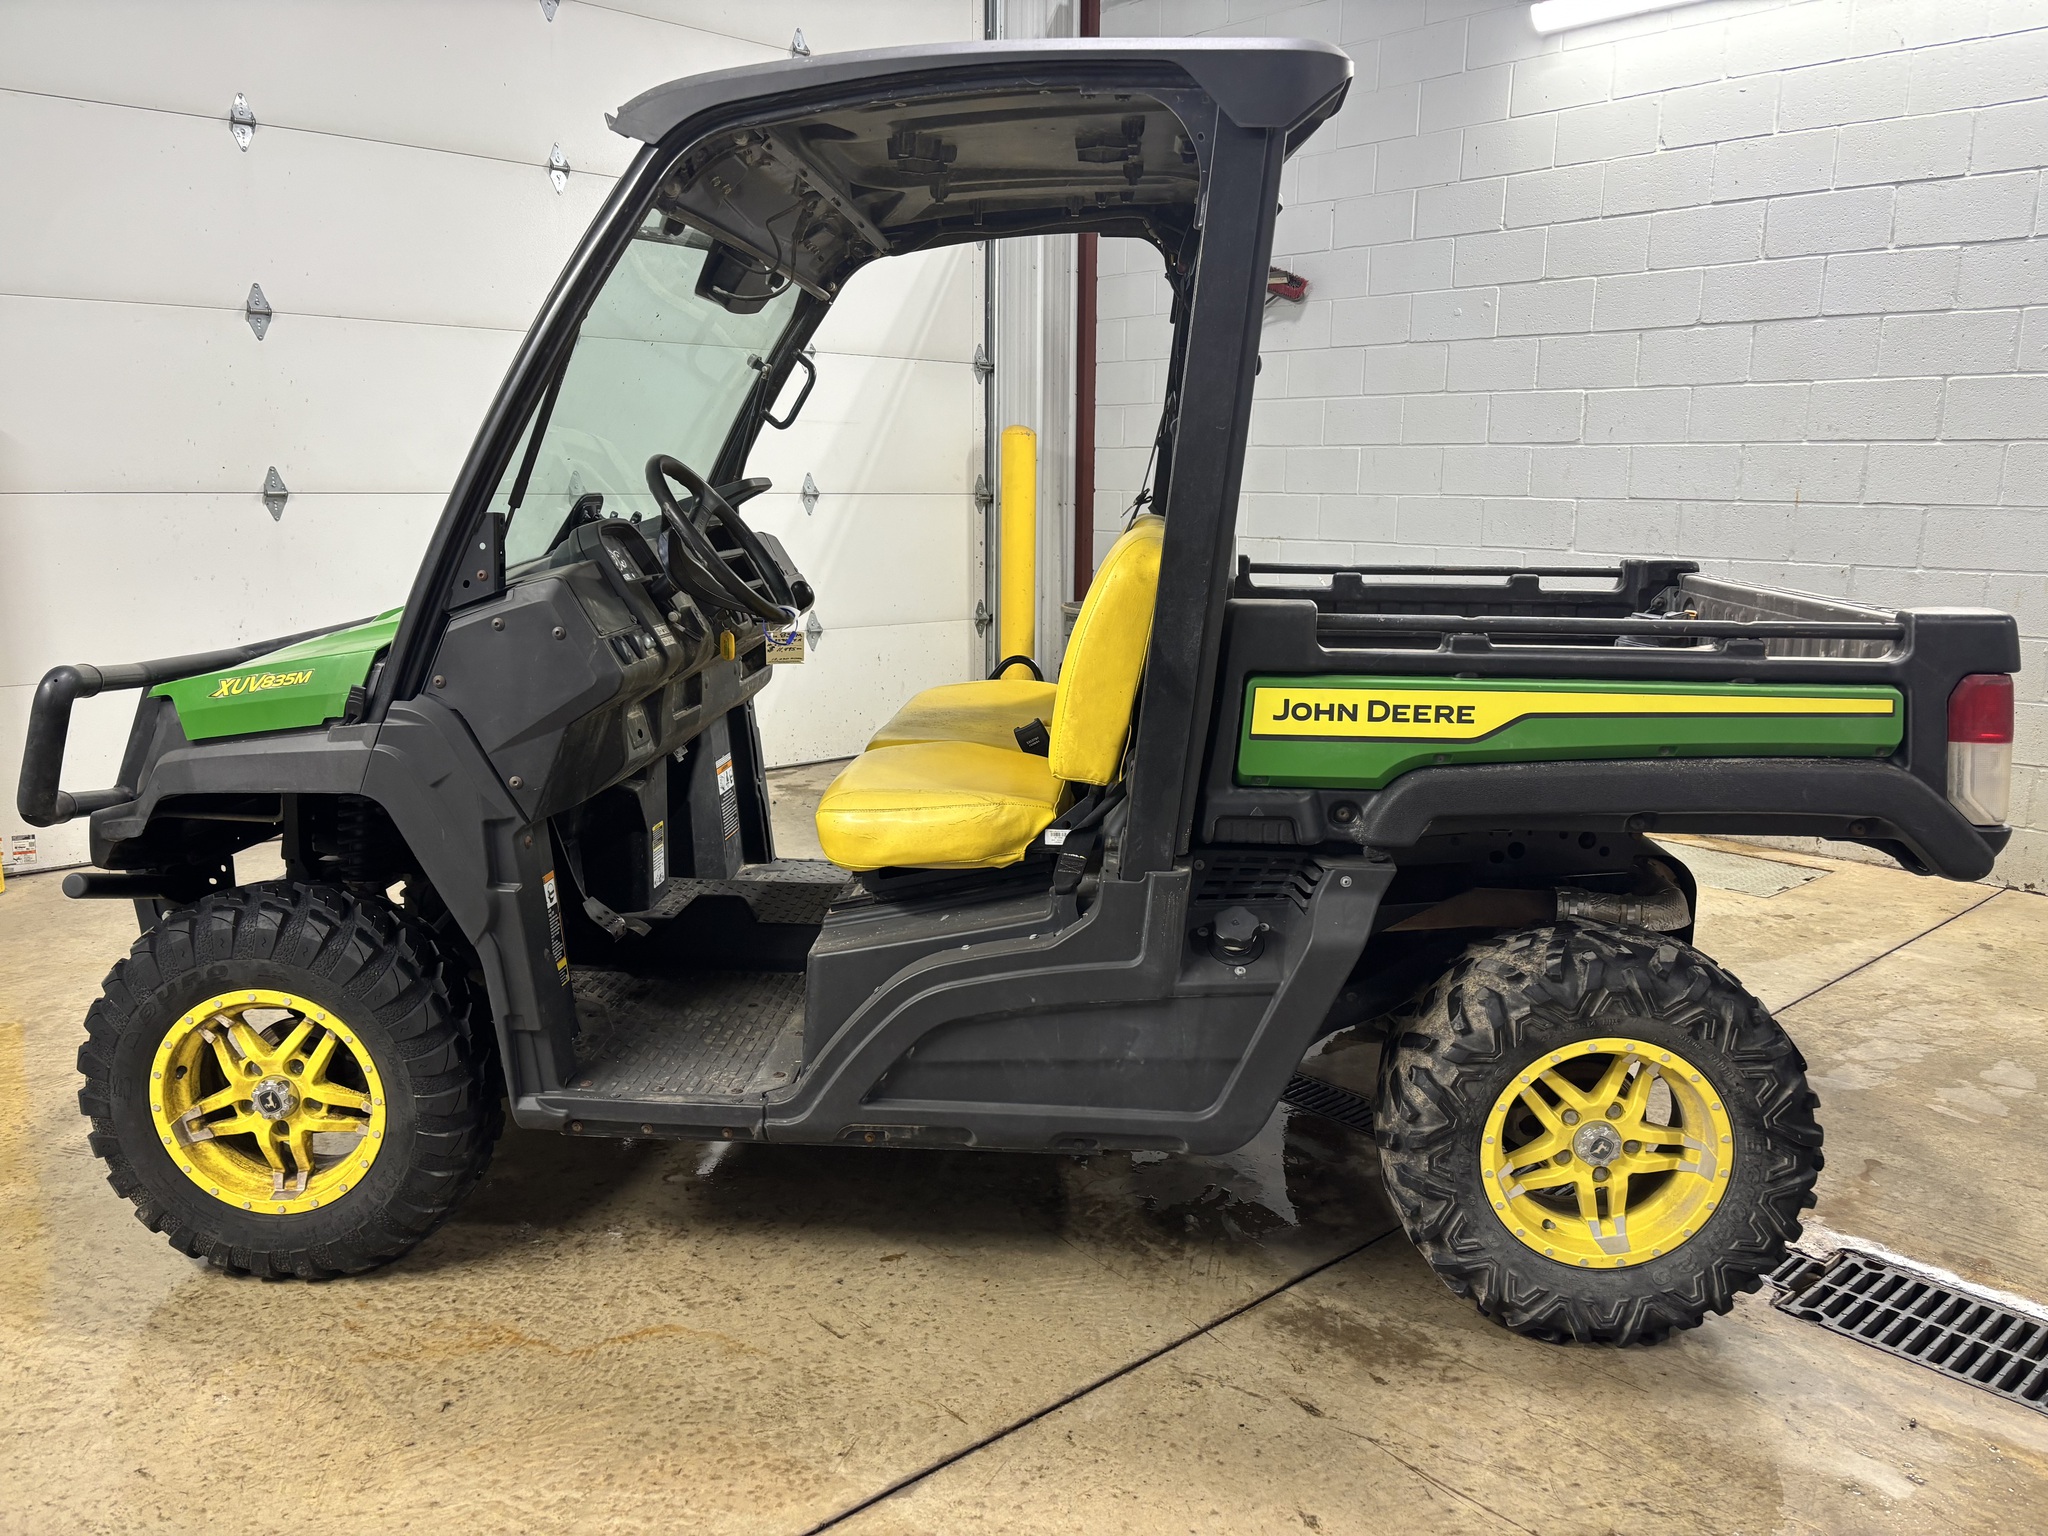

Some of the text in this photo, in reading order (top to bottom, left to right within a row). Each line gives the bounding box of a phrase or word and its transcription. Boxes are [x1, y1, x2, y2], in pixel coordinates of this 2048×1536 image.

[208, 669, 315, 698] XUV835M
[1272, 698, 1476, 724] JOHN DEERE
